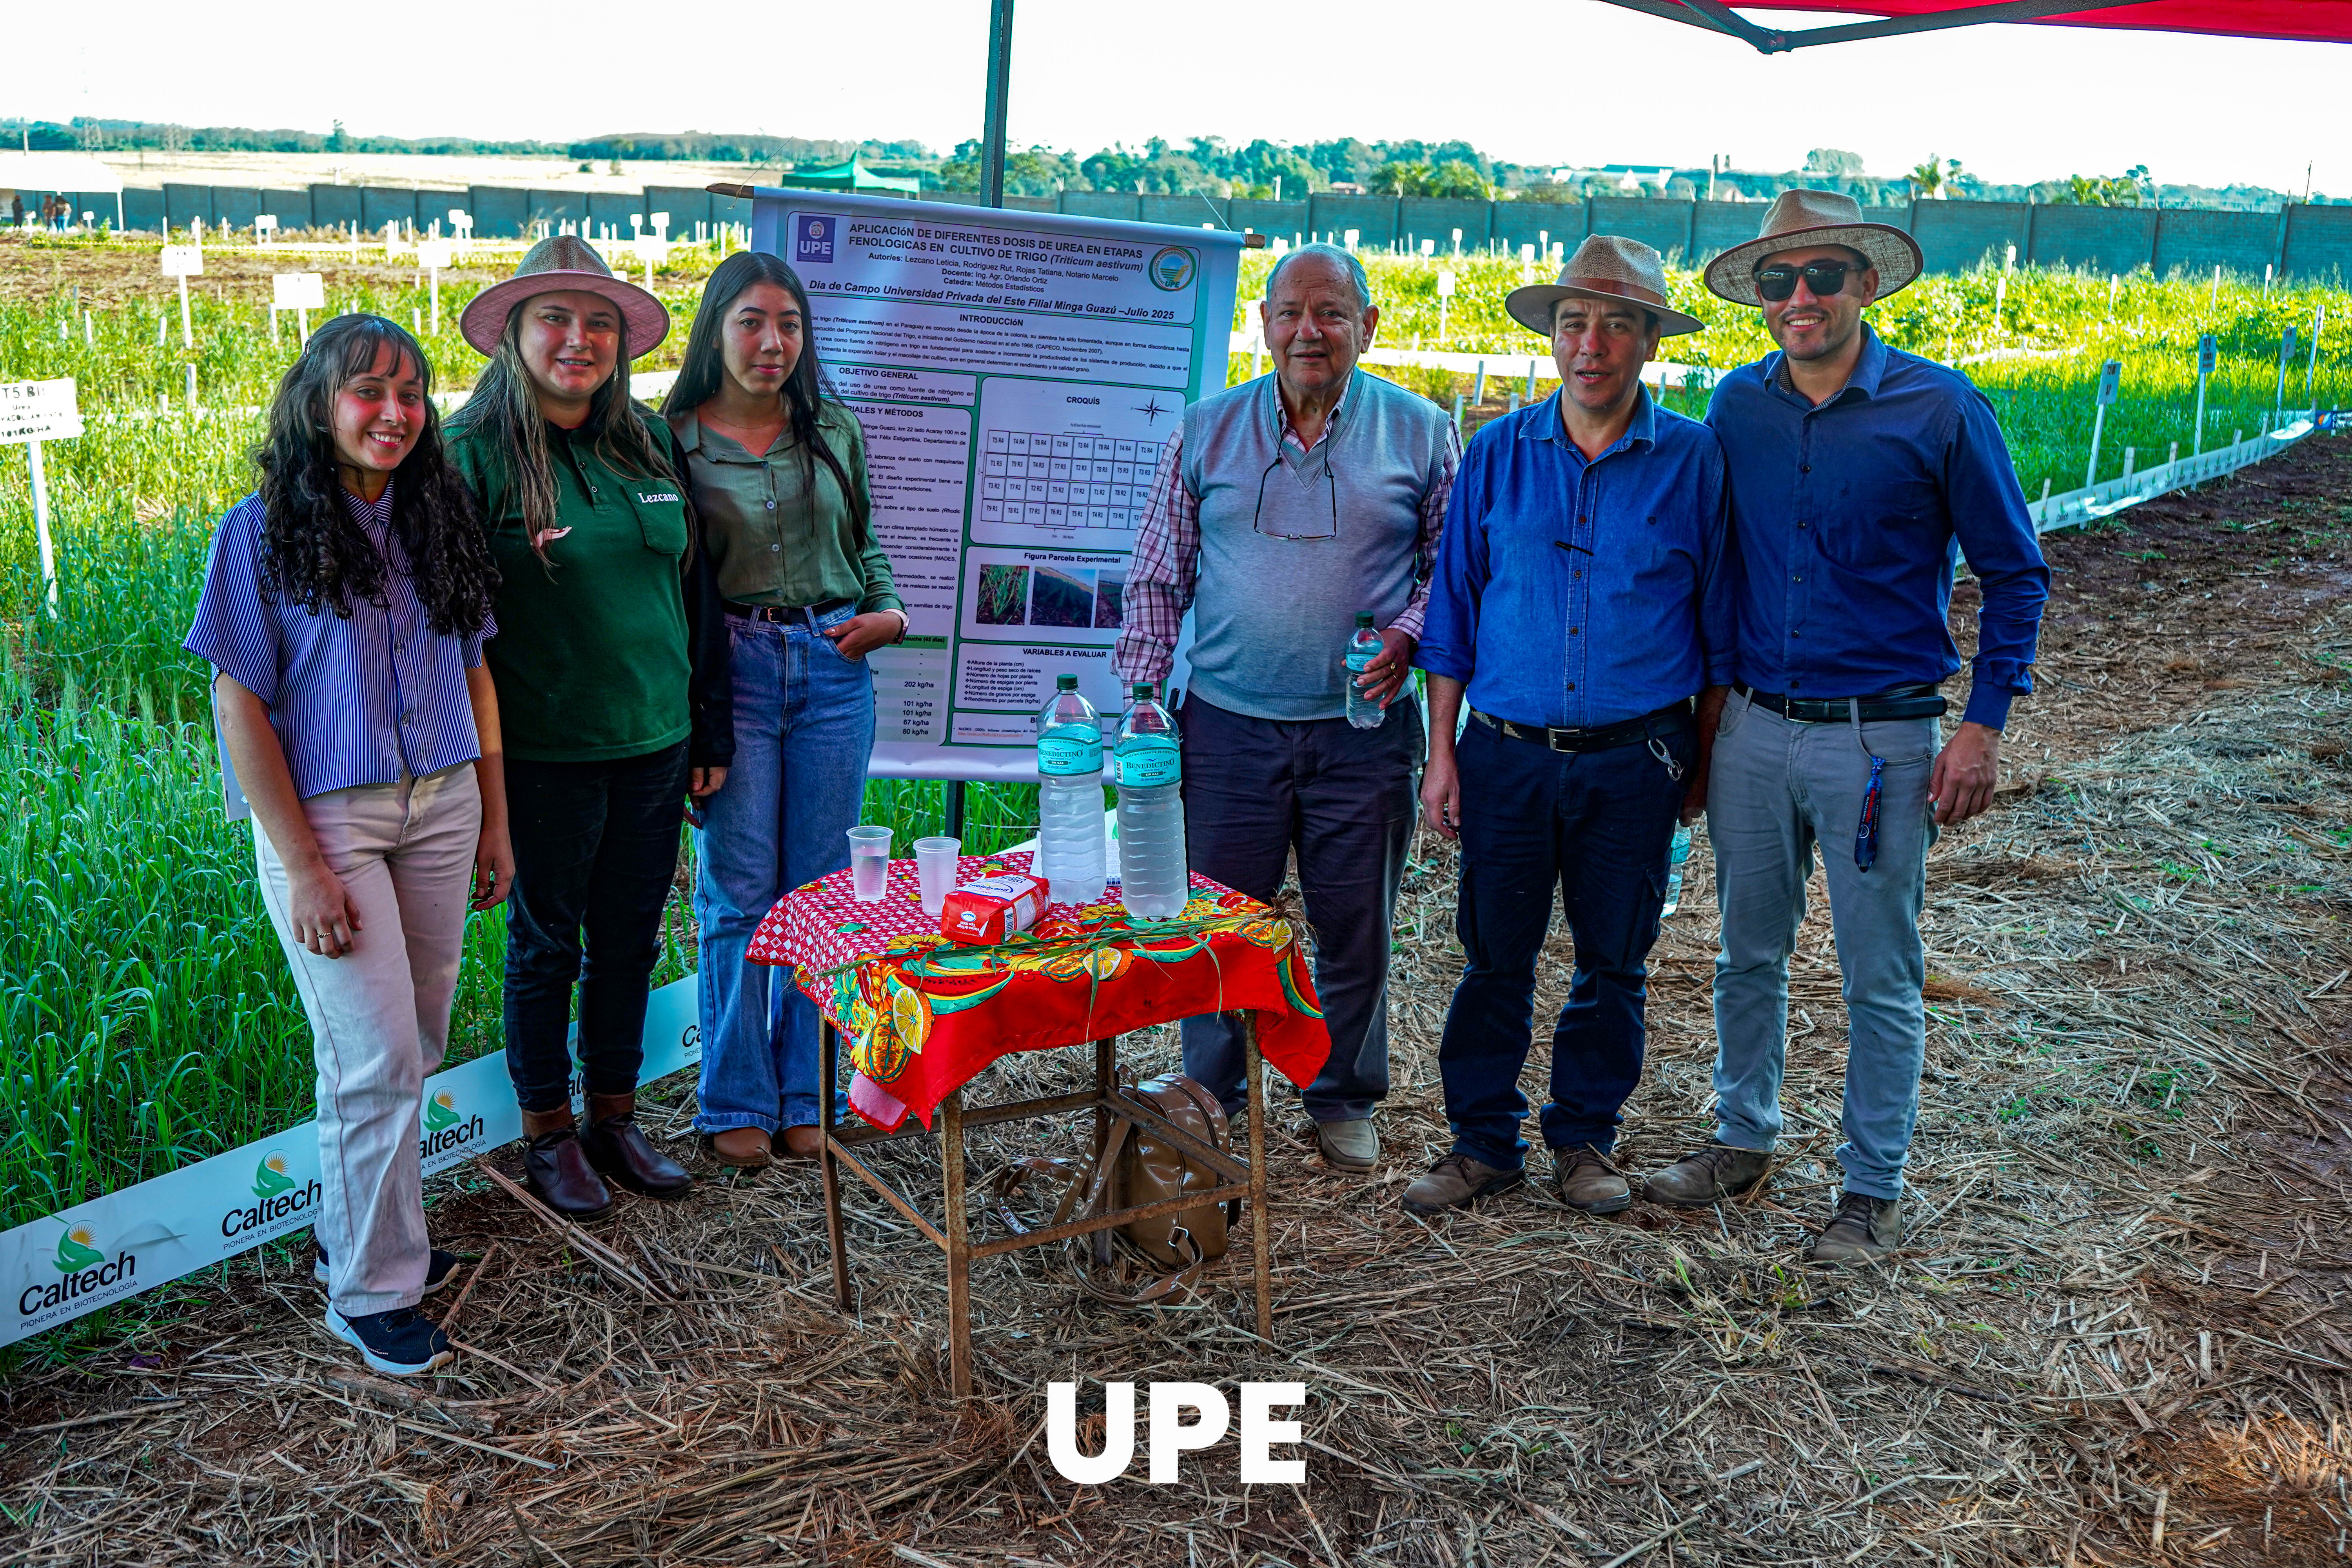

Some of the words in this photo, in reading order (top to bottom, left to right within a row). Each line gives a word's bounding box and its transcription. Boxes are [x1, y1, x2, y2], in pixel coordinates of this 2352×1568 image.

[800, 241, 831, 254] UPE
[918, 229, 931, 238] DE
[935, 230, 1000, 245] DIFERENTES
[1004, 237, 1035, 248] DOSIS
[1039, 241, 1053, 250] DE
[1056, 242, 1083, 253] UREA
[1087, 245, 1101, 254] EN
[1104, 247, 1142, 258] ETAPAS
[868, 252, 902, 261] Autor/es:
[905, 255, 934, 264] Lezcano
[936, 258, 960, 267] Leticia,
[1000, 264, 1013, 272] Rut,
[1016, 266, 1036, 274] Rojas
[1038, 268, 1063, 277] Tatiana,
[1066, 270, 1090, 279] Notario
[1092, 273, 1119, 281] Marcelo
[930, 243, 944, 252] EN
[950, 245, 995, 257] CULTIVO
[998, 249, 1012, 259] DE
[1015, 251, 1047, 262] TRIGO
[1051, 254, 1094, 266] (Triticum
[1096, 261, 1143, 273] aestivum)
[942, 269, 973, 277] Docente:
[1004, 274, 1030, 282] Orlando
[944, 278, 973, 286] Catedra:
[1005, 283, 1044, 292] Estadísticos
[809, 280, 826, 289] Dia
[829, 281, 841, 290] de
[845, 283, 880, 294] Campo
[884, 285, 944, 298] Universidad
[946, 291, 984, 302] Privada
[987, 295, 1002, 304] del
[1004, 296, 1025, 306] Este
[1028, 298, 1053, 308] Filial
[1054, 301, 1083, 312] Minga
[1086, 303, 1116, 314] Guazú
[1151, 310, 1174, 319] 2025
[839, 367, 878, 376] OBJETIVO
[881, 371, 918, 380] GENERAL
[885, 408, 923, 417] MÉTODOS
[1067, 396, 1100, 405] CROQUÍS
[638, 492, 679, 503] Lezcano
[1039, 748, 1083, 757] BENEDICTINO
[1126, 758, 1174, 768] BENEDICTINO
[420, 1114, 483, 1160] altech
[439, 1139, 486, 1163] BIOTECNOLOGÍA
[222, 1179, 321, 1237] Caltech
[223, 1234, 255, 1250] PIONERA
[270, 1209, 318, 1232] BIOTECNOLOG
[19, 1251, 136, 1315] Caltech
[20, 1312, 57, 1330] PIONERA
[60, 1306, 71, 1314] EN
[74, 1279, 138, 1309] BIOTECNOLOGÍA
